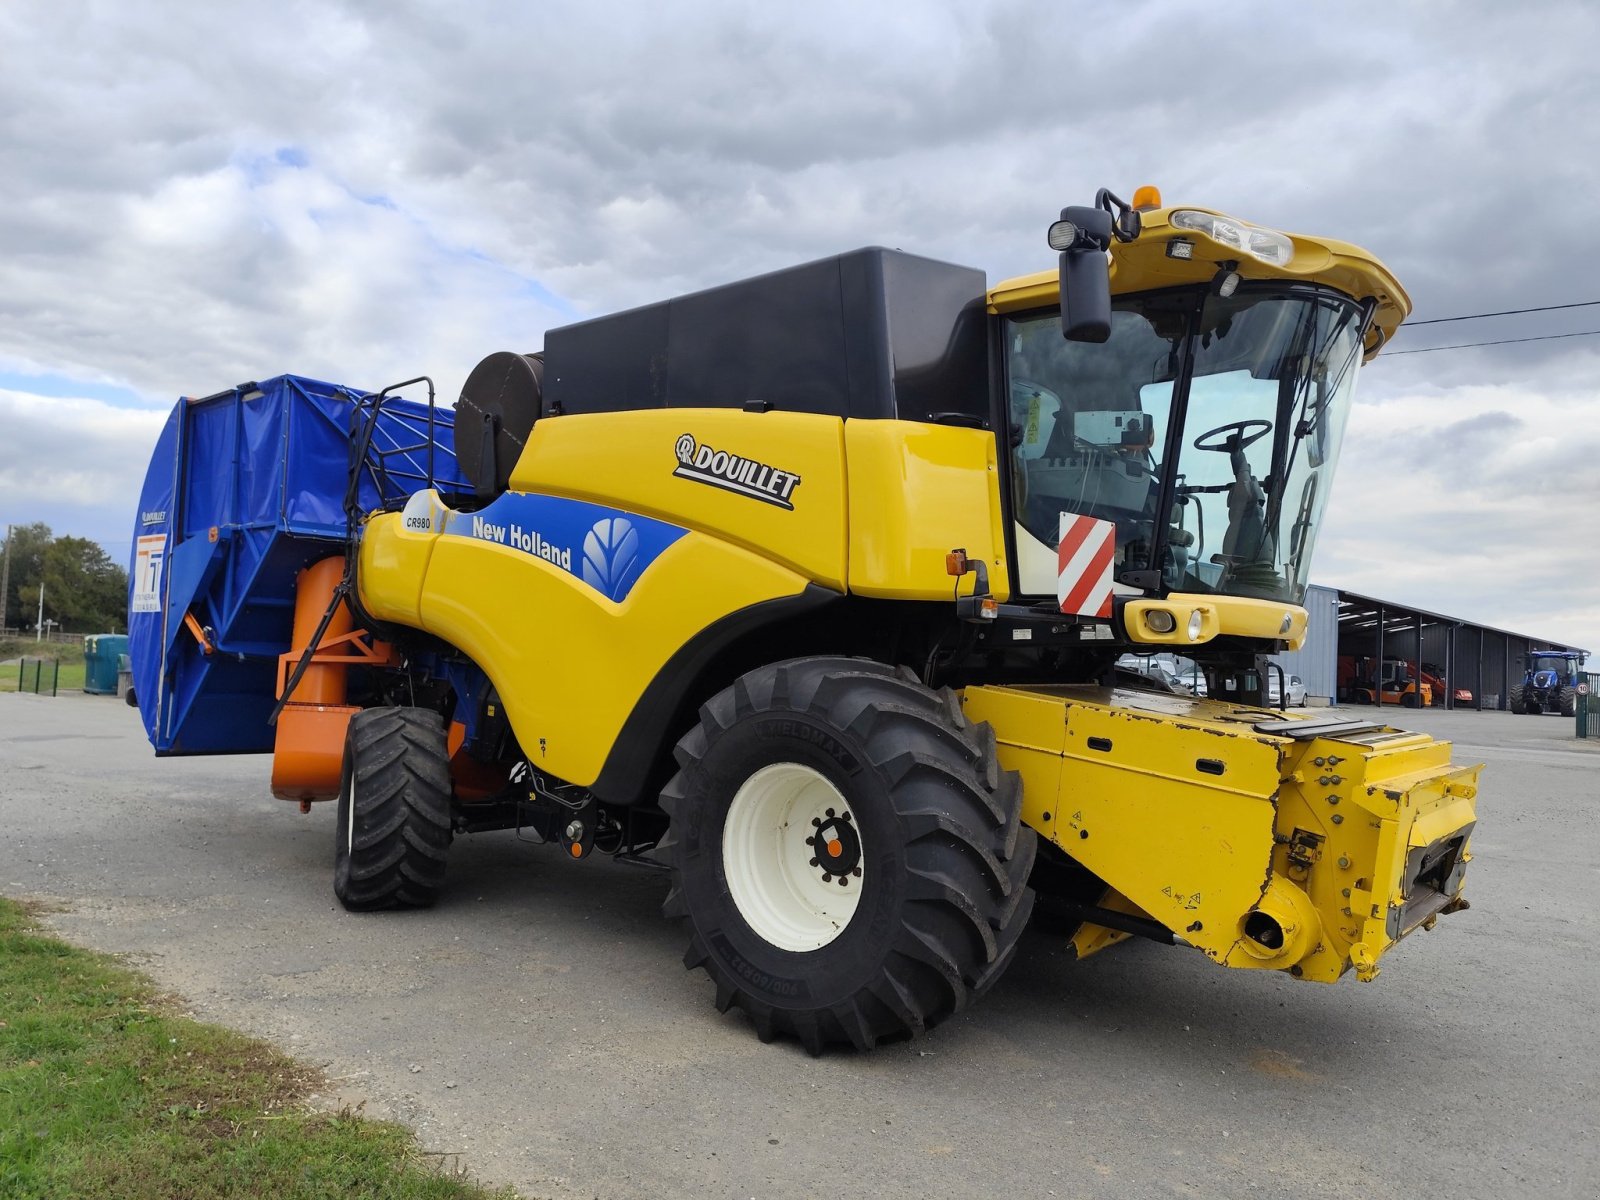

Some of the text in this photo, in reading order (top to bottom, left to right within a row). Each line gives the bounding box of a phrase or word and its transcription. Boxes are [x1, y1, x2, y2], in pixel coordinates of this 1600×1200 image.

[694, 444, 800, 499] DOUILLET
[407, 517, 431, 529] CR980
[473, 516, 571, 571] New Holland
[767, 721, 850, 762] YIELDMAX
